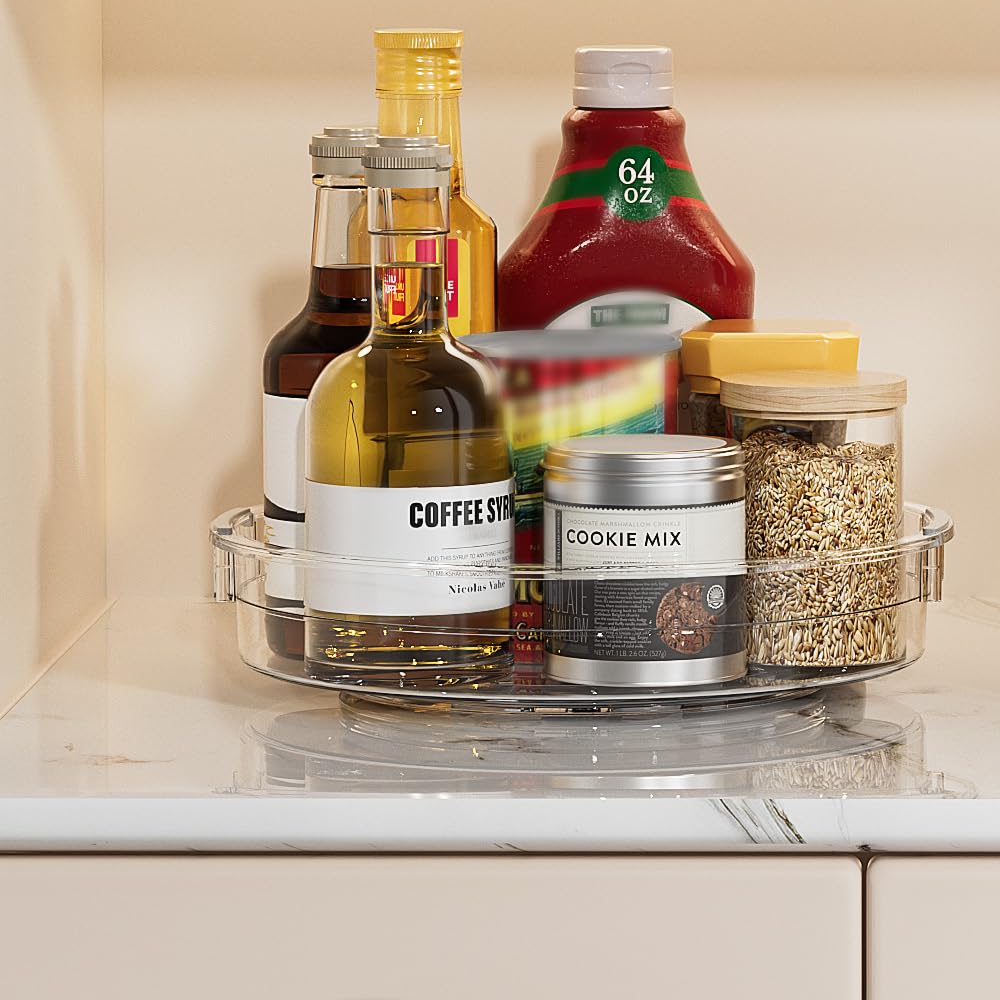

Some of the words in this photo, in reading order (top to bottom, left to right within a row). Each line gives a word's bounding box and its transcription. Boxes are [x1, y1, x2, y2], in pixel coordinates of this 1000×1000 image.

[618, 157, 655, 185] 64
[409, 499, 484, 529] COFFEE
[566, 528, 637, 547] COOKIE
[644, 531, 682, 547] MIX
[448, 583, 487, 594] Nicolas
[594, 649, 605, 657] NET
